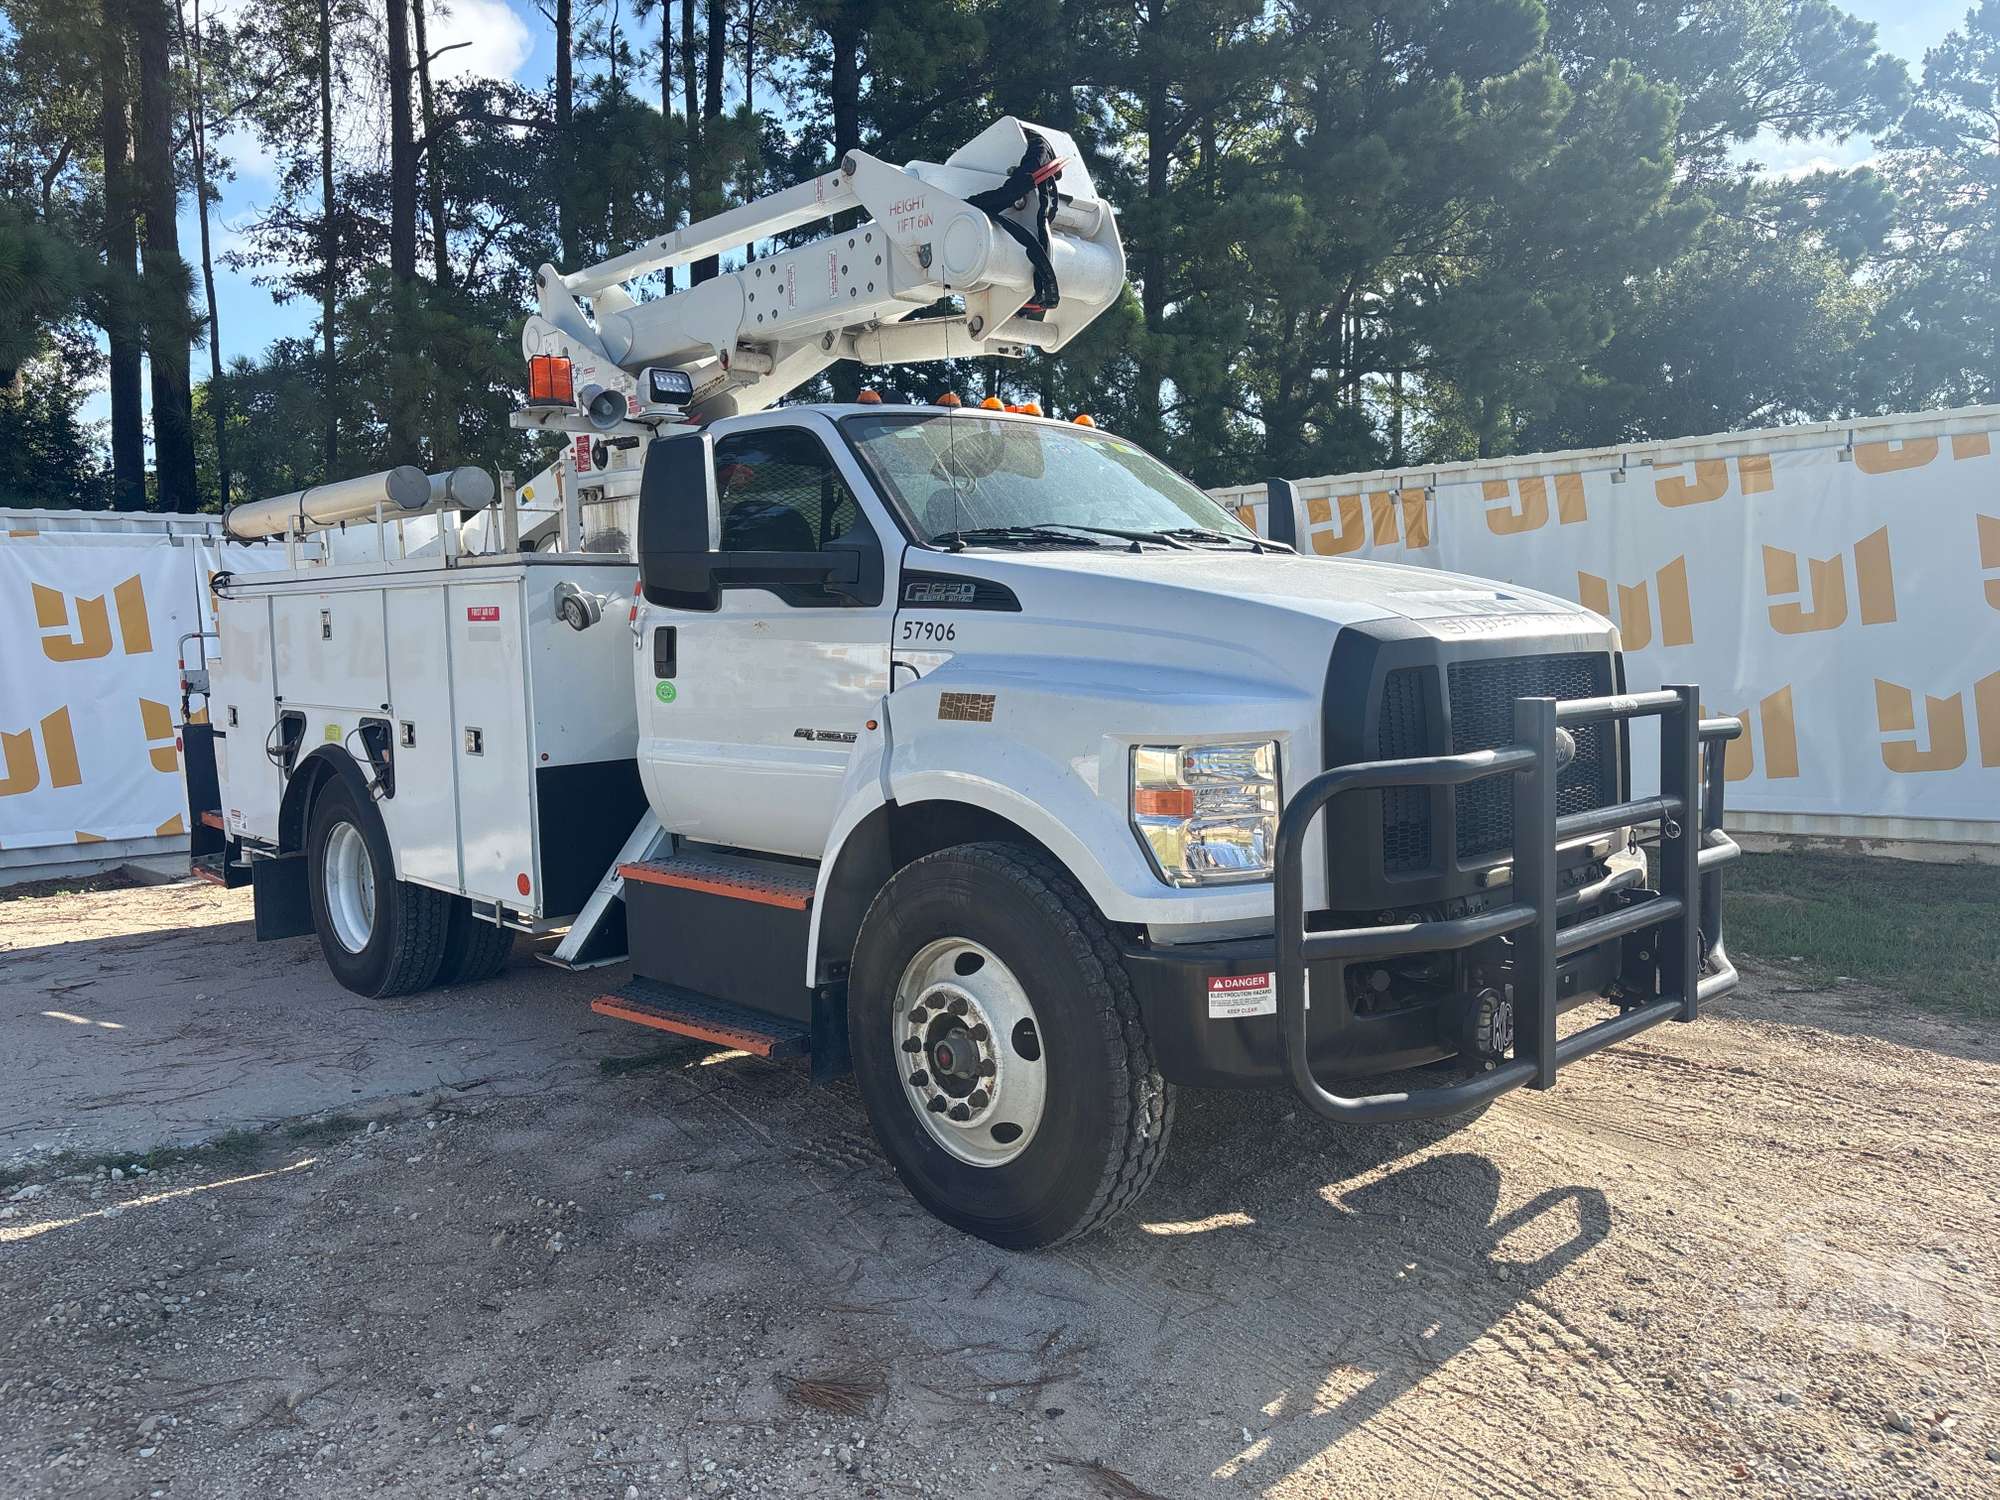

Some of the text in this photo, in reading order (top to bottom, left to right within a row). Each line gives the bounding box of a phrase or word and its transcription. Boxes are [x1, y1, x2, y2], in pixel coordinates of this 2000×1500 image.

[889, 192, 927, 216] HEIGHT
[902, 620, 956, 642] 57906
[1224, 976, 1266, 988] DANGER
